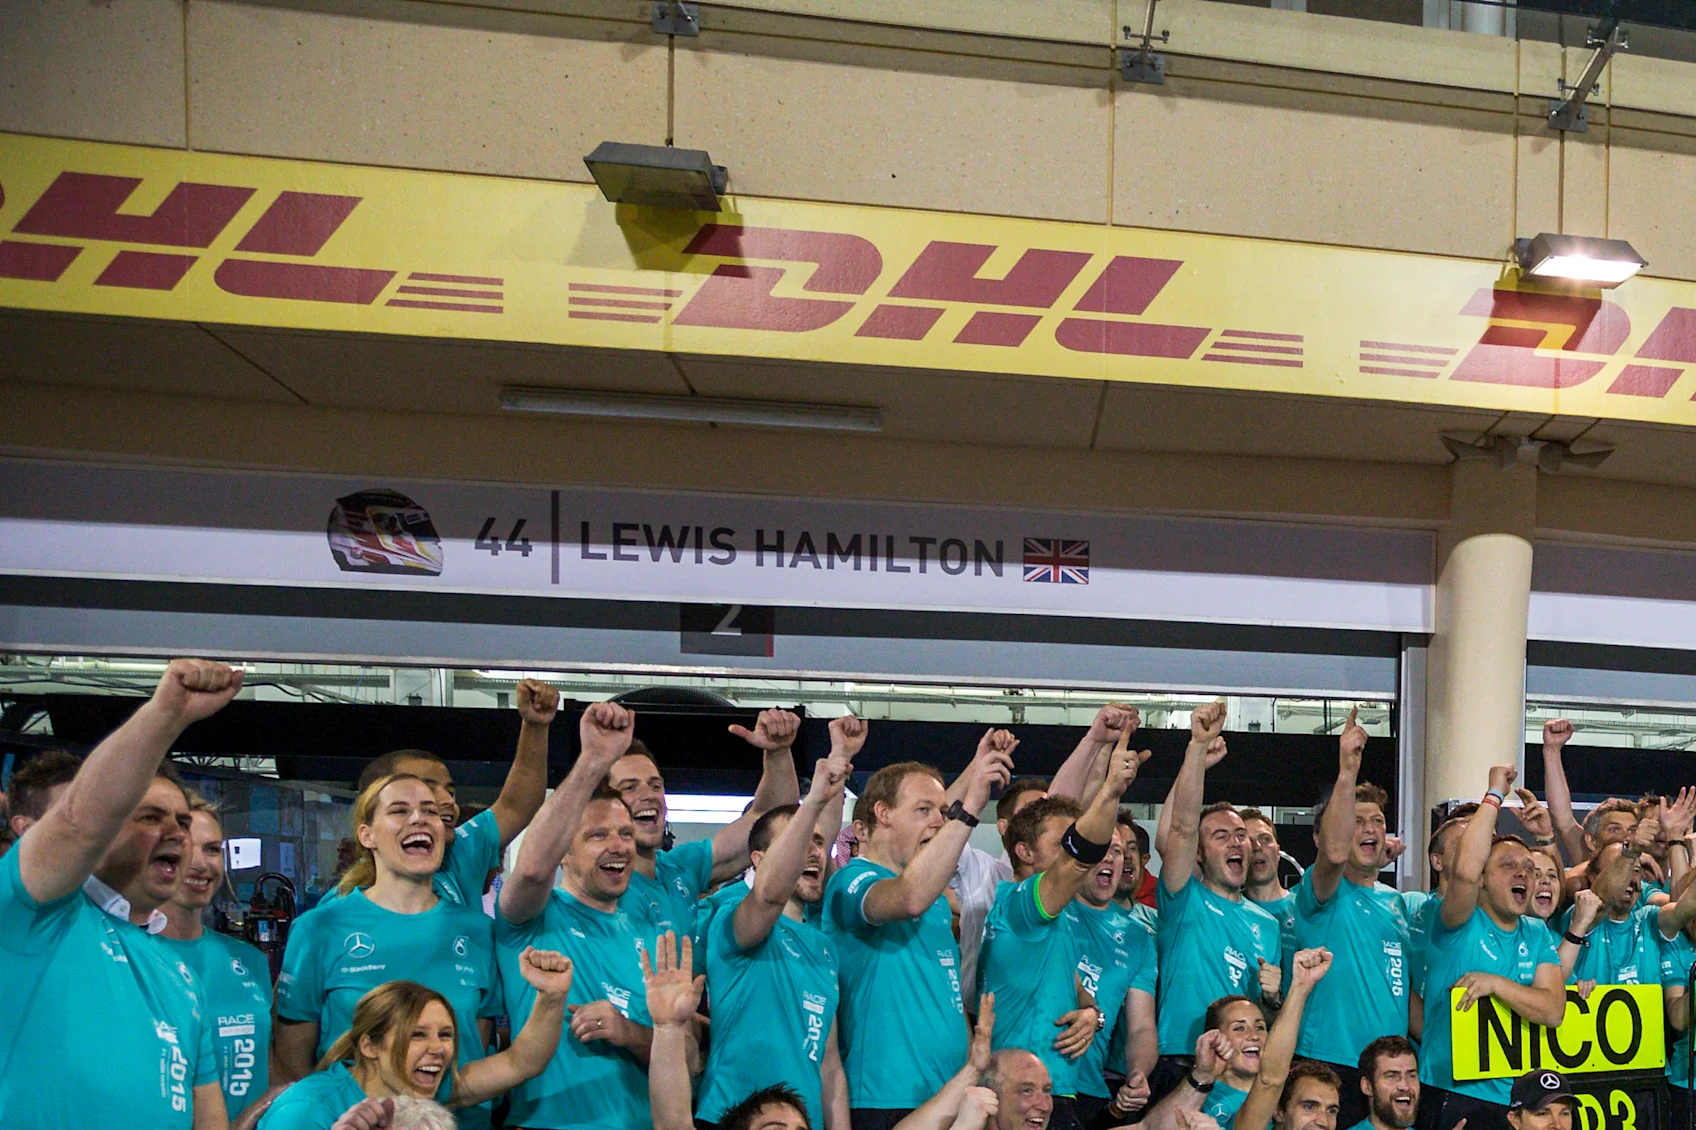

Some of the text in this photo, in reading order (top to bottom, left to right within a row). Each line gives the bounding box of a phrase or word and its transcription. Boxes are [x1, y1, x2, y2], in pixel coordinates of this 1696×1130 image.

[0, 171, 398, 305] HL
[672, 222, 1212, 359] DHL
[475, 517, 533, 557] 44
[581, 522, 1004, 577] LEWIS HAMILTON
[1390, 957, 1404, 997] 2015
[217, 1013, 255, 1026] RACE
[1479, 989, 1643, 1072] NICO
[170, 1046, 189, 1112] 2015
[229, 1039, 255, 1097] 2015
